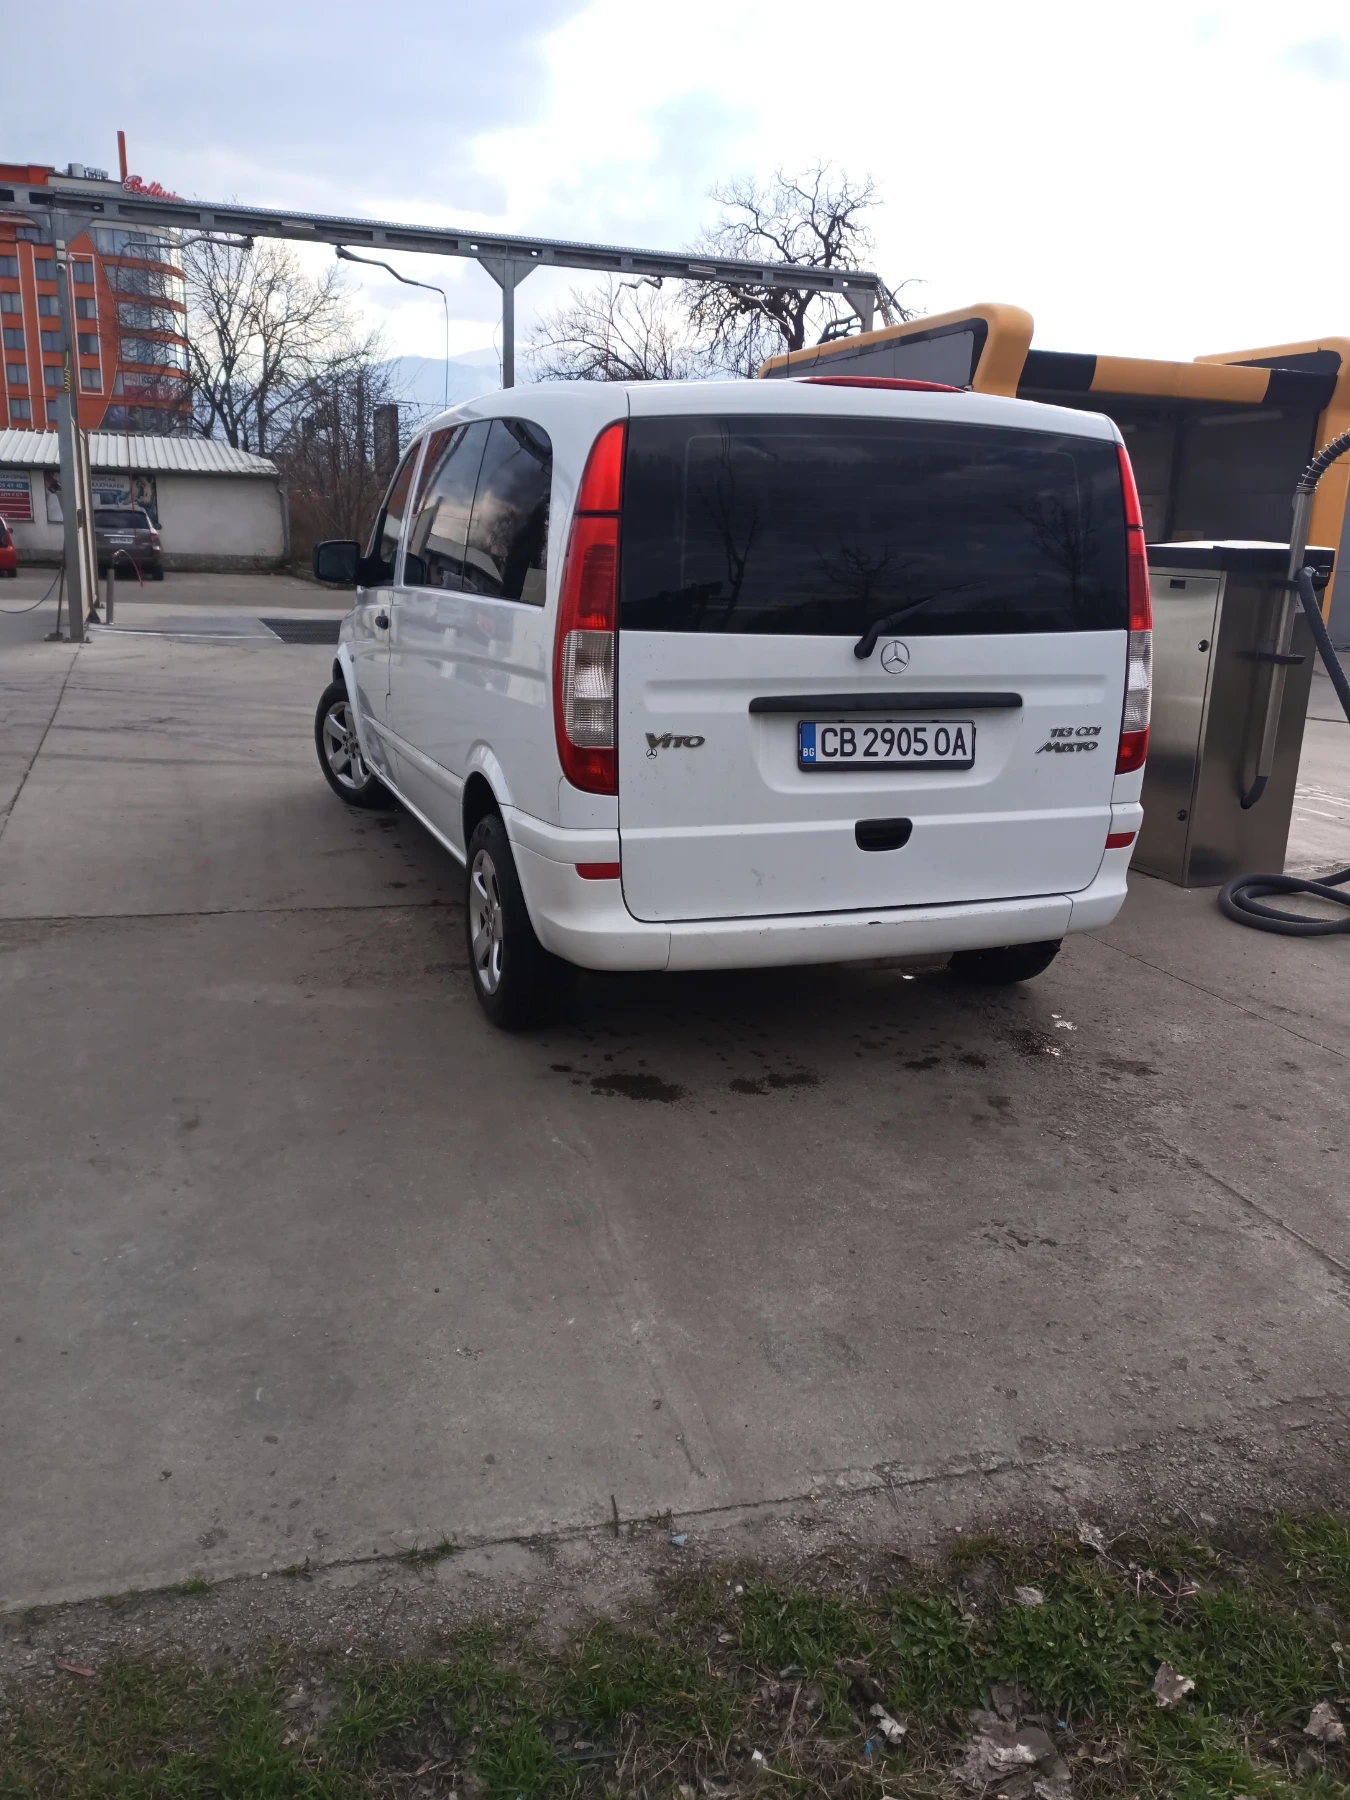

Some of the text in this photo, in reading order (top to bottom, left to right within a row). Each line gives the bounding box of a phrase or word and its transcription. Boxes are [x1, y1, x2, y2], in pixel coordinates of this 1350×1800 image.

[821, 727, 967, 757] CB 2905 OA
[802, 748, 815, 757] BG
